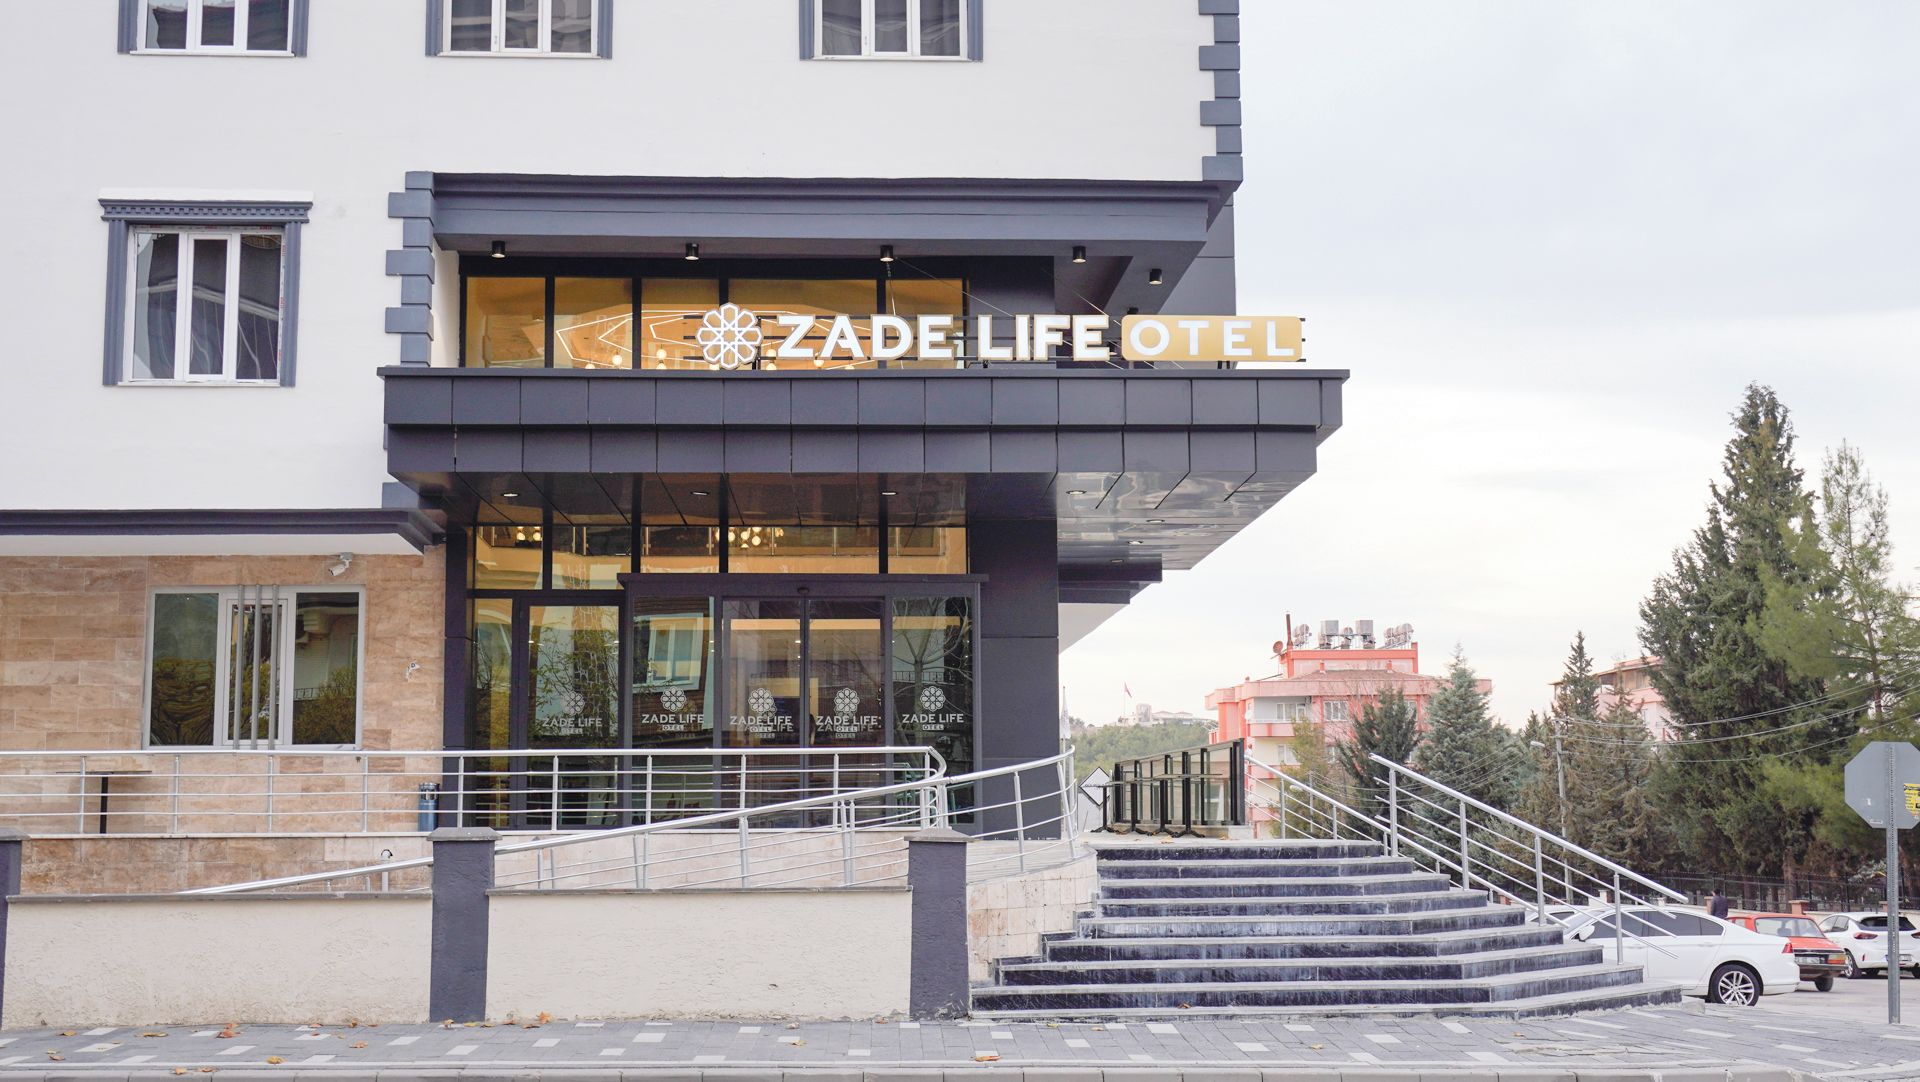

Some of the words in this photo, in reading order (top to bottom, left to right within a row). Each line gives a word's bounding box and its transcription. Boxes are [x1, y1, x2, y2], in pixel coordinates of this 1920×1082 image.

[777, 314, 954, 360] ZADE
[978, 314, 1110, 361] LIFE
[1129, 319, 1295, 356] OTEL
[542, 717, 575, 727] ZADE
[578, 717, 603, 727] LIFE
[641, 713, 676, 724] ZADE
[679, 713, 704, 724] LIFE
[730, 715, 764, 725] ZADE
[767, 715, 793, 725] LIFE
[816, 715, 850, 725] ZADE
[853, 715, 878, 725] LIFE
[902, 713, 936, 723] ZADE
[939, 713, 964, 723] LIFE
